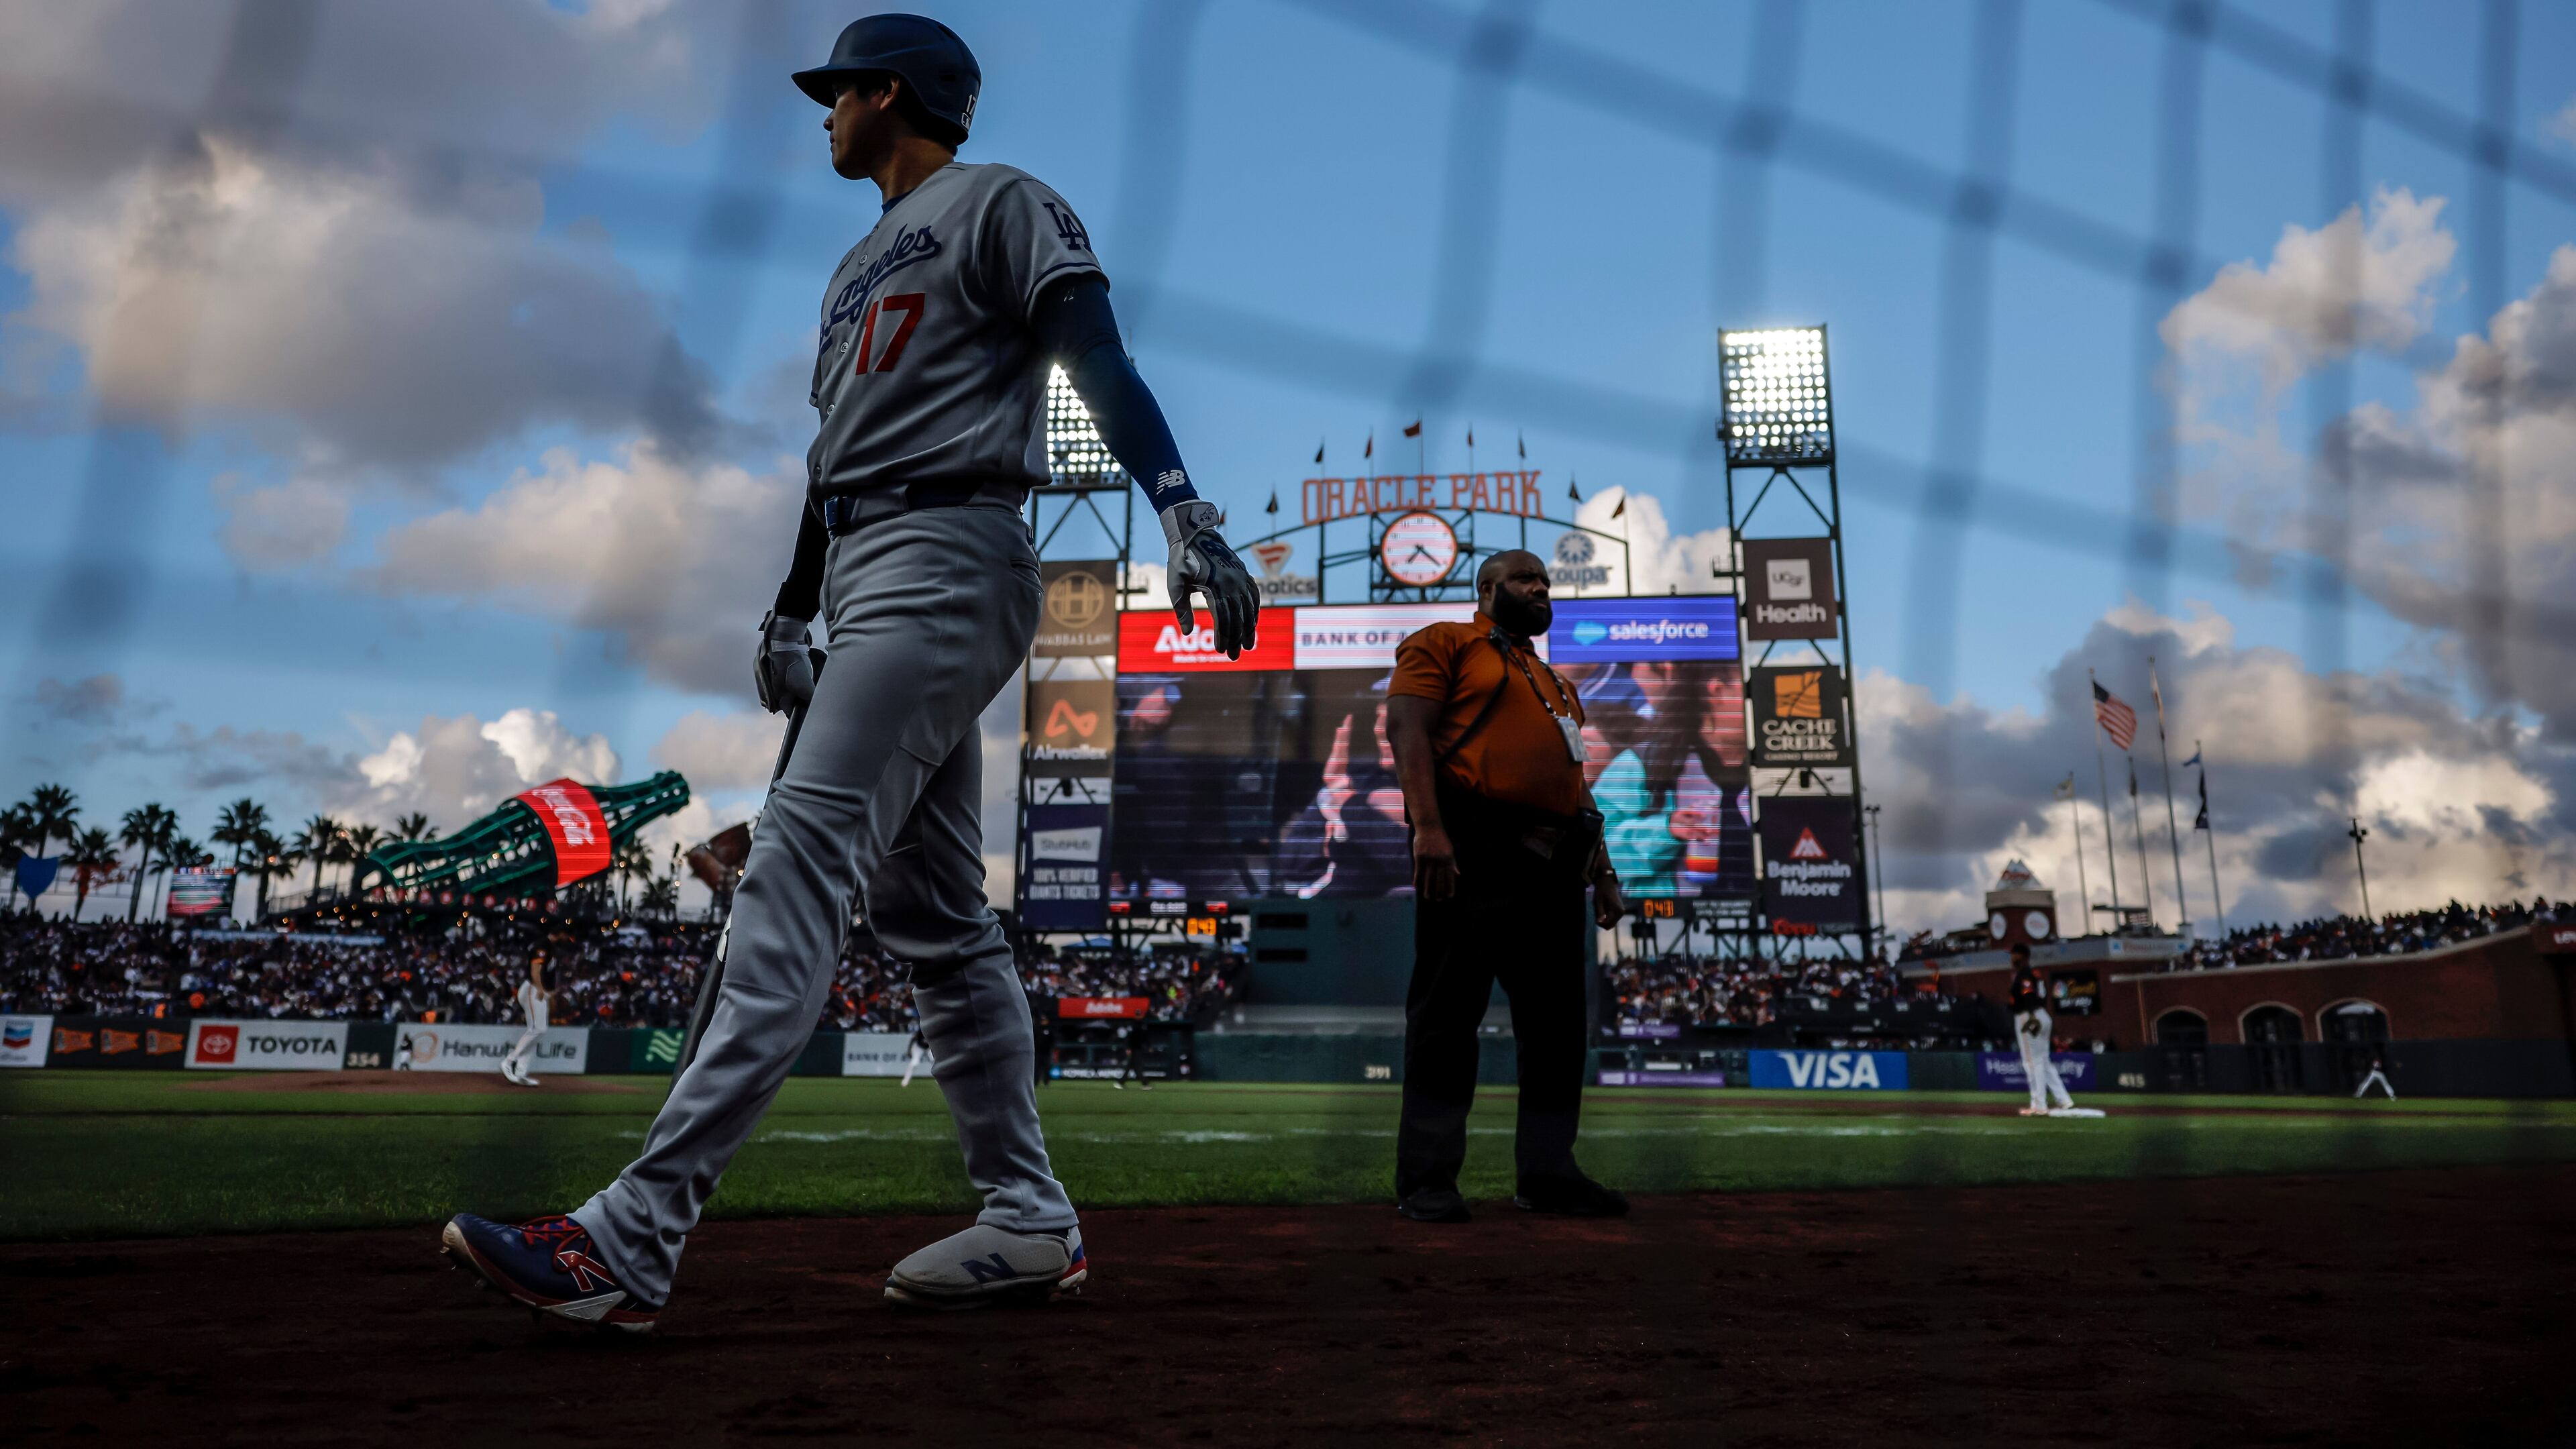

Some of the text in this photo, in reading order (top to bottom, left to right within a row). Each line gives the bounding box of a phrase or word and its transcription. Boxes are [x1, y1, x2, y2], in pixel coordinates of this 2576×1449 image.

[855, 292, 926, 376] 17
[1303, 470, 1544, 527] ORACLE PARK
[1756, 603, 1827, 624] Health
[1301, 633, 1358, 647] BANK
[1365, 631, 1389, 645] OF
[1609, 619, 1709, 644] salesforce
[1762, 718, 1837, 735] CACHE
[1766, 735, 1835, 751] CREEK
[1767, 859, 1851, 881] Benjamin
[1780, 879, 1840, 896] Moore
[248, 1036, 336, 1055] TOYOTA
[537, 1040, 576, 1059] Life
[347, 1052, 381, 1067] 354
[1777, 1051, 1881, 1088] VISA
